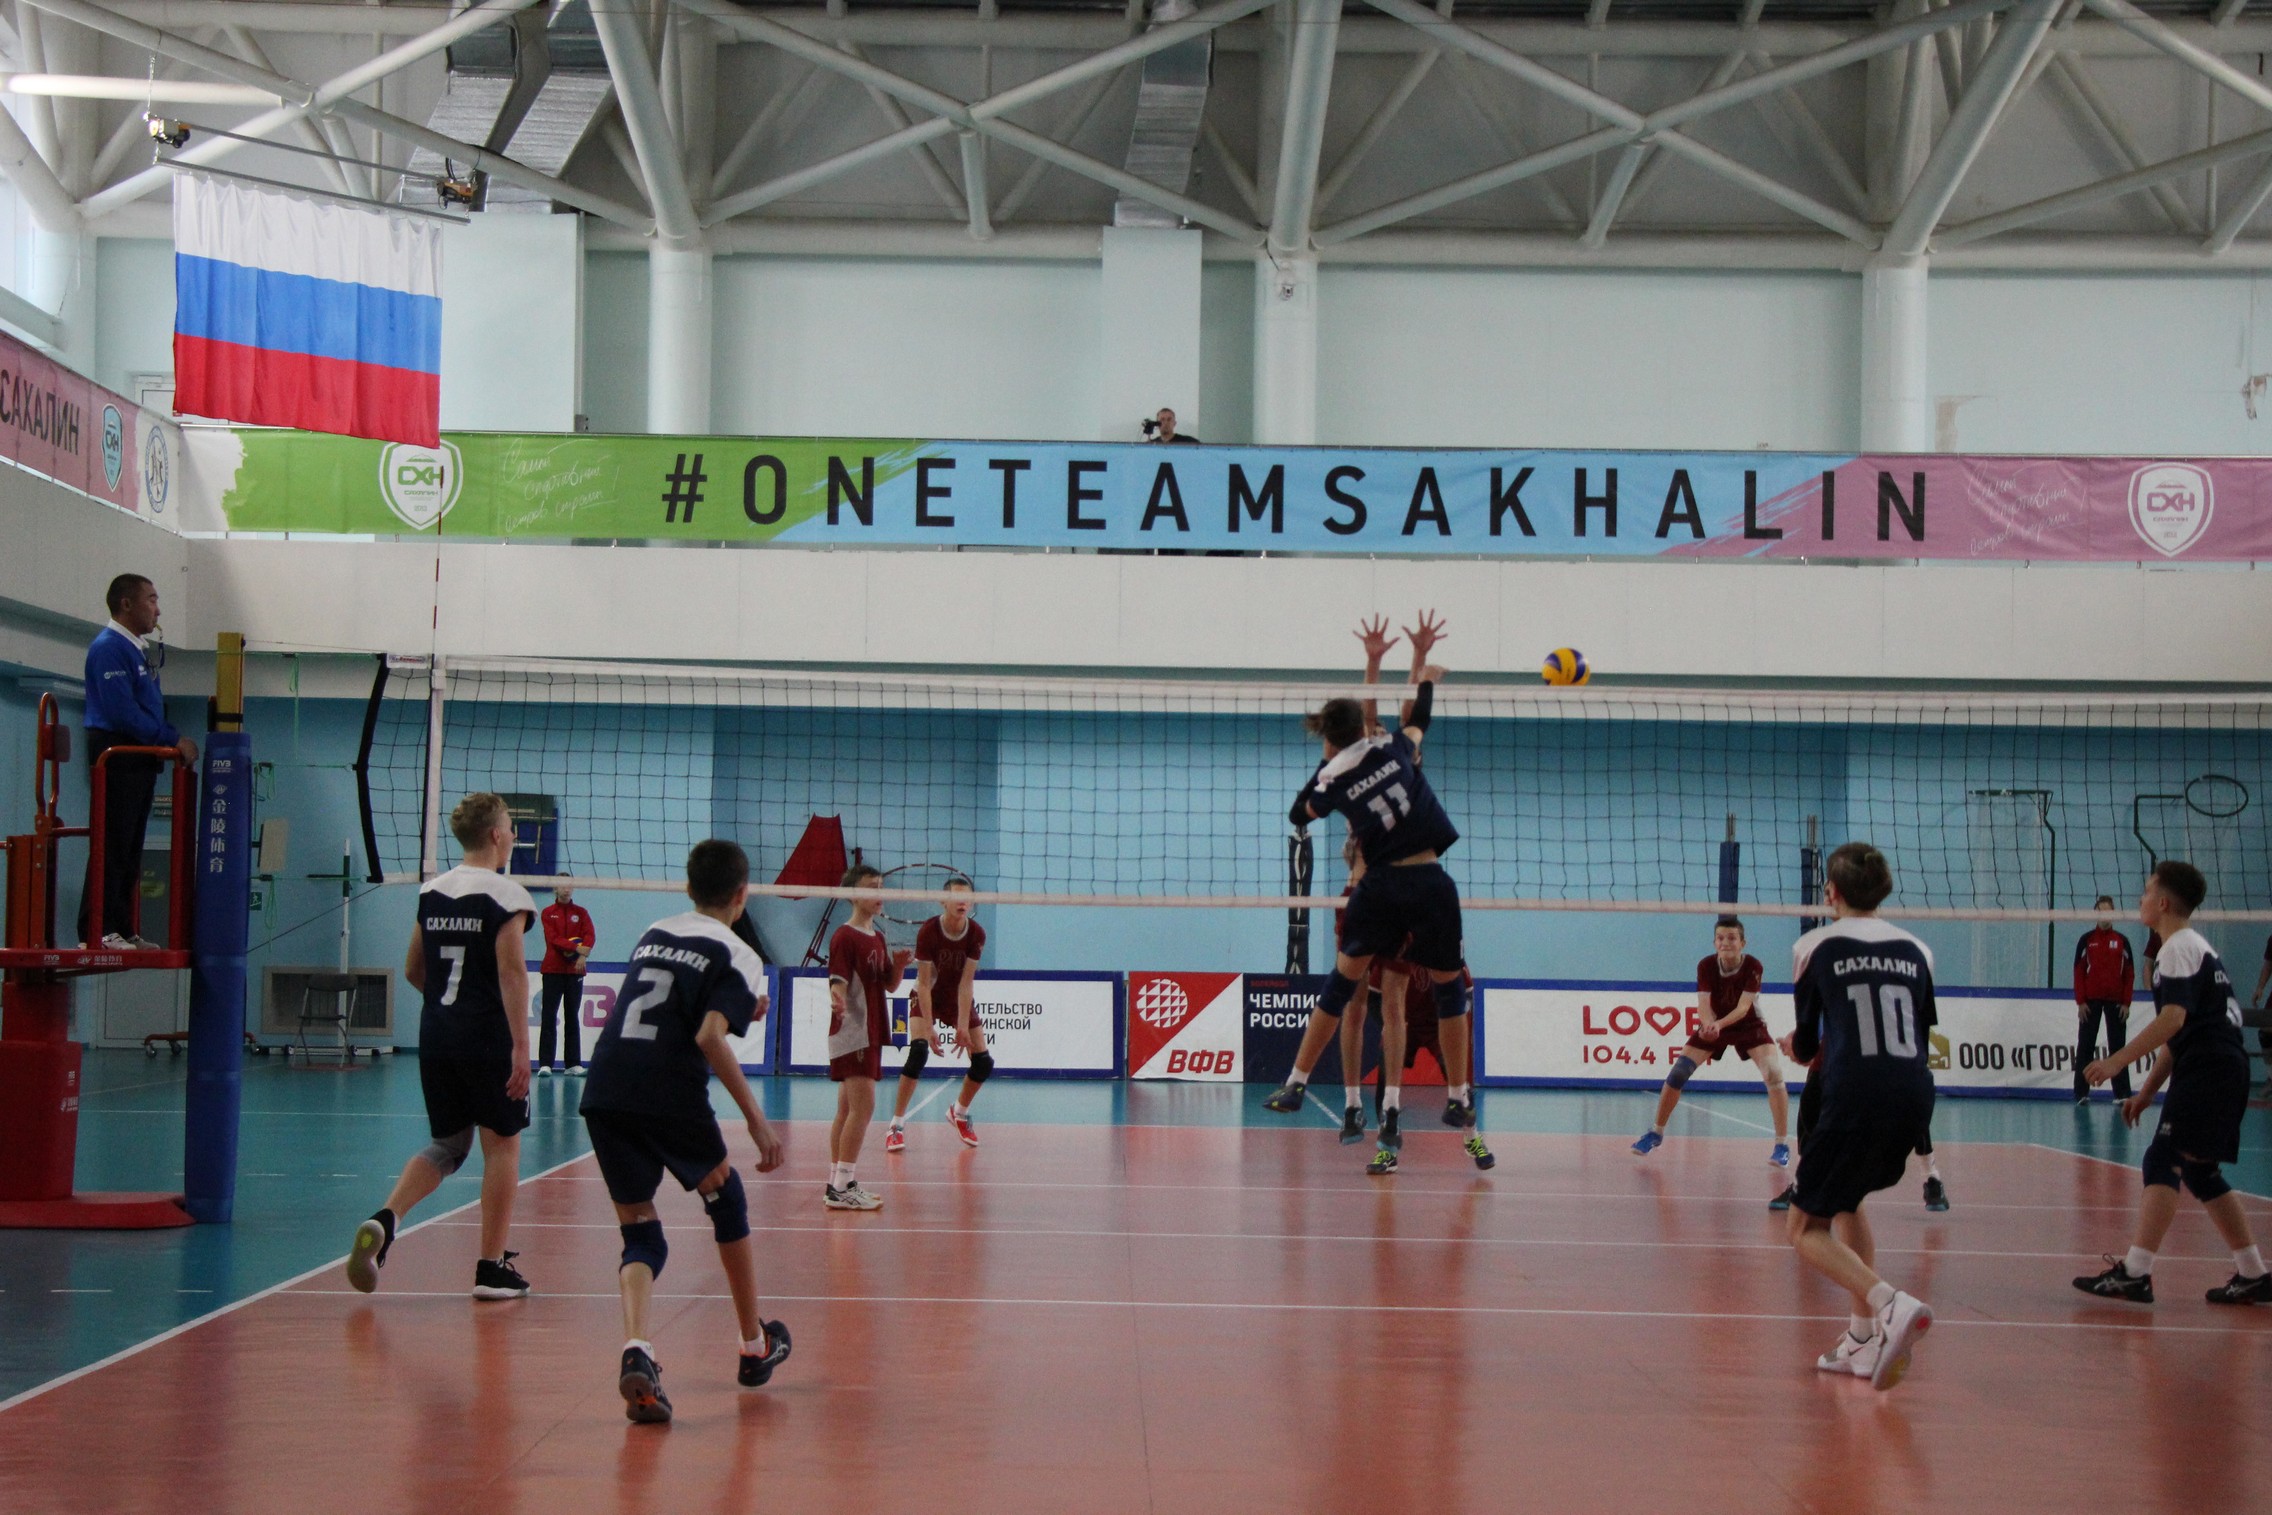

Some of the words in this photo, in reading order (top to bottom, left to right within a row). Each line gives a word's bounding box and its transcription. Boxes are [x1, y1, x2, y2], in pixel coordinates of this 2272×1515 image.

[0, 369, 80, 456] САХАЛИН
[661, 453, 1925, 541] #ONETEAMSAKHALIN
[1346, 759, 1401, 800] САХАЛИН
[426, 917, 482, 932] САХАЛИН
[633, 944, 711, 972] САХАЛИН
[1833, 956, 1917, 978] САХАЛИН
[440, 946, 467, 1006] 7
[620, 967, 675, 1040] 2
[1250, 1013, 1310, 1029] РОССИ
[1847, 983, 1917, 1058] 10
[1167, 1049, 1235, 1074] ВФВ
[1583, 1045, 1656, 1064] 104.4
[1959, 1042, 2004, 1070] ООО
